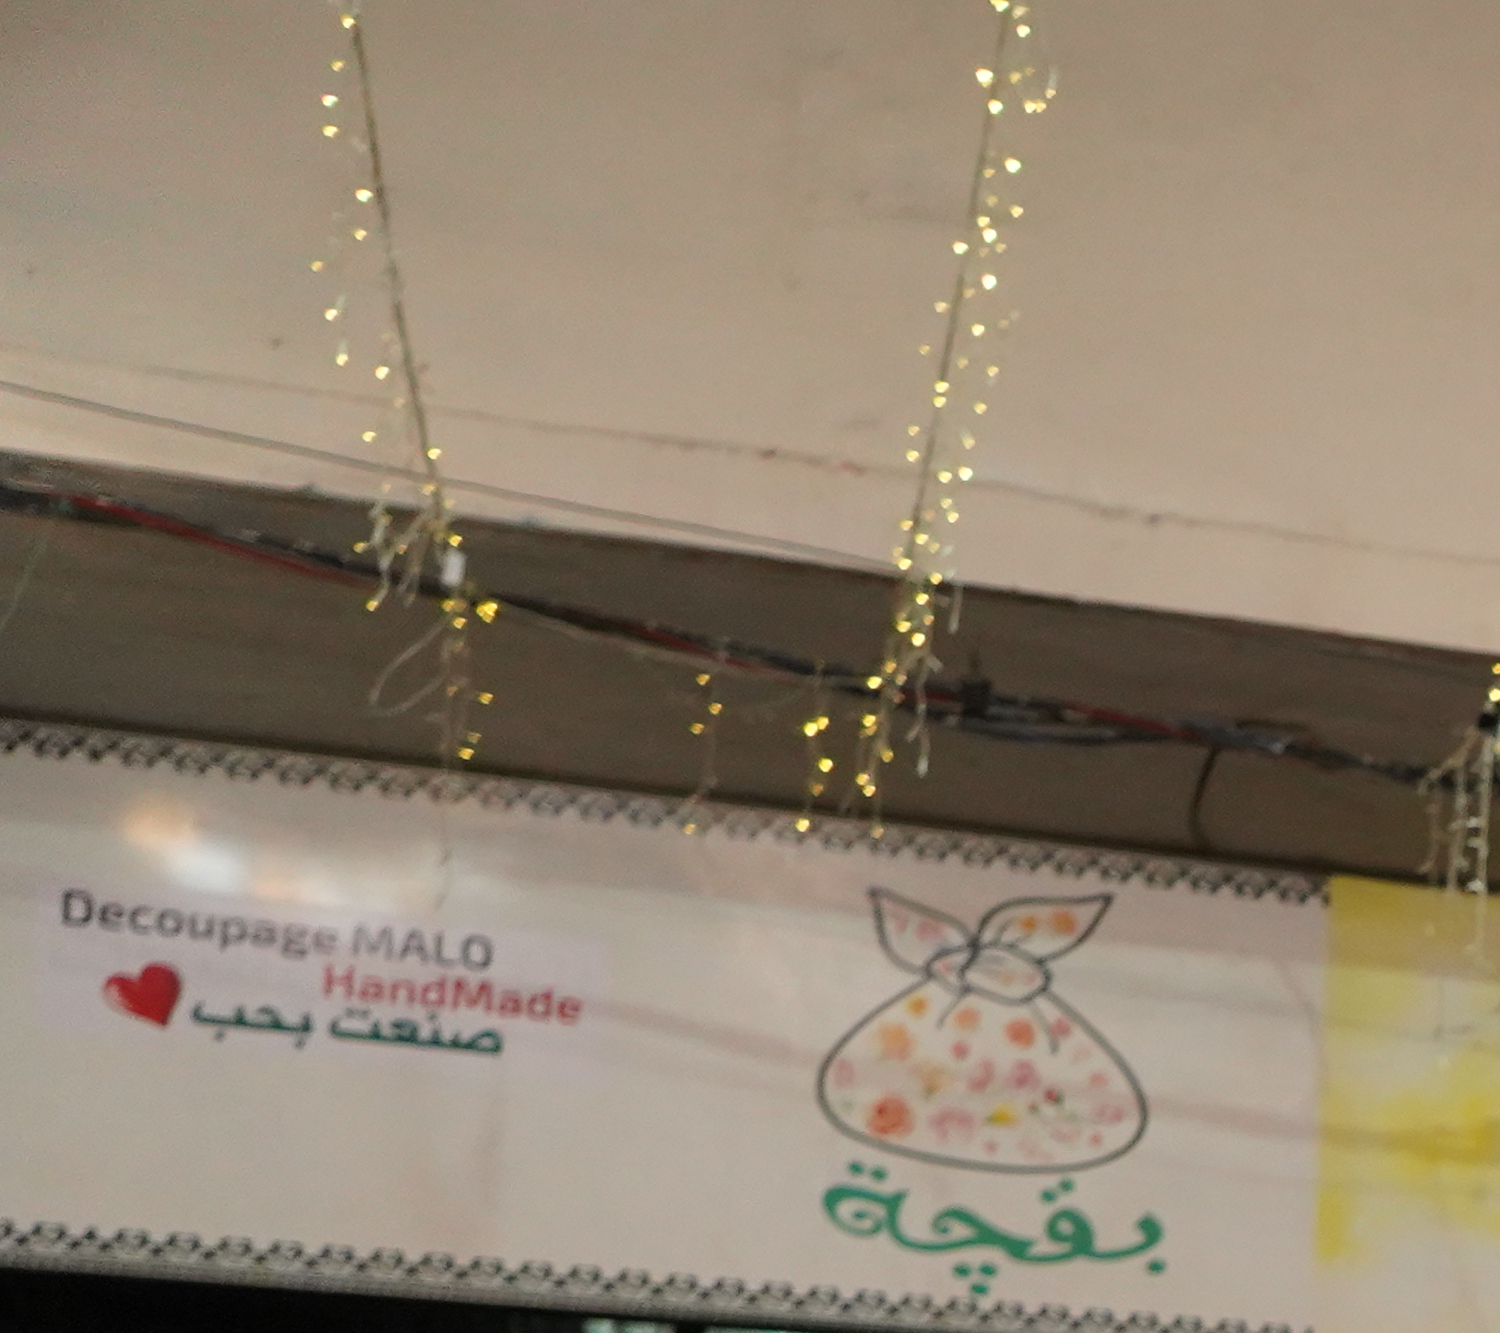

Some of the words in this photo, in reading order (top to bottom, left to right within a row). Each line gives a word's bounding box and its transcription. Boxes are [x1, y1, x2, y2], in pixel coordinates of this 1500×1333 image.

[60, 887, 340, 956] Decoupage
[351, 922, 495, 971] MALO
[190, 1000, 314, 1049] بحب
[322, 963, 585, 1026] HandMade
